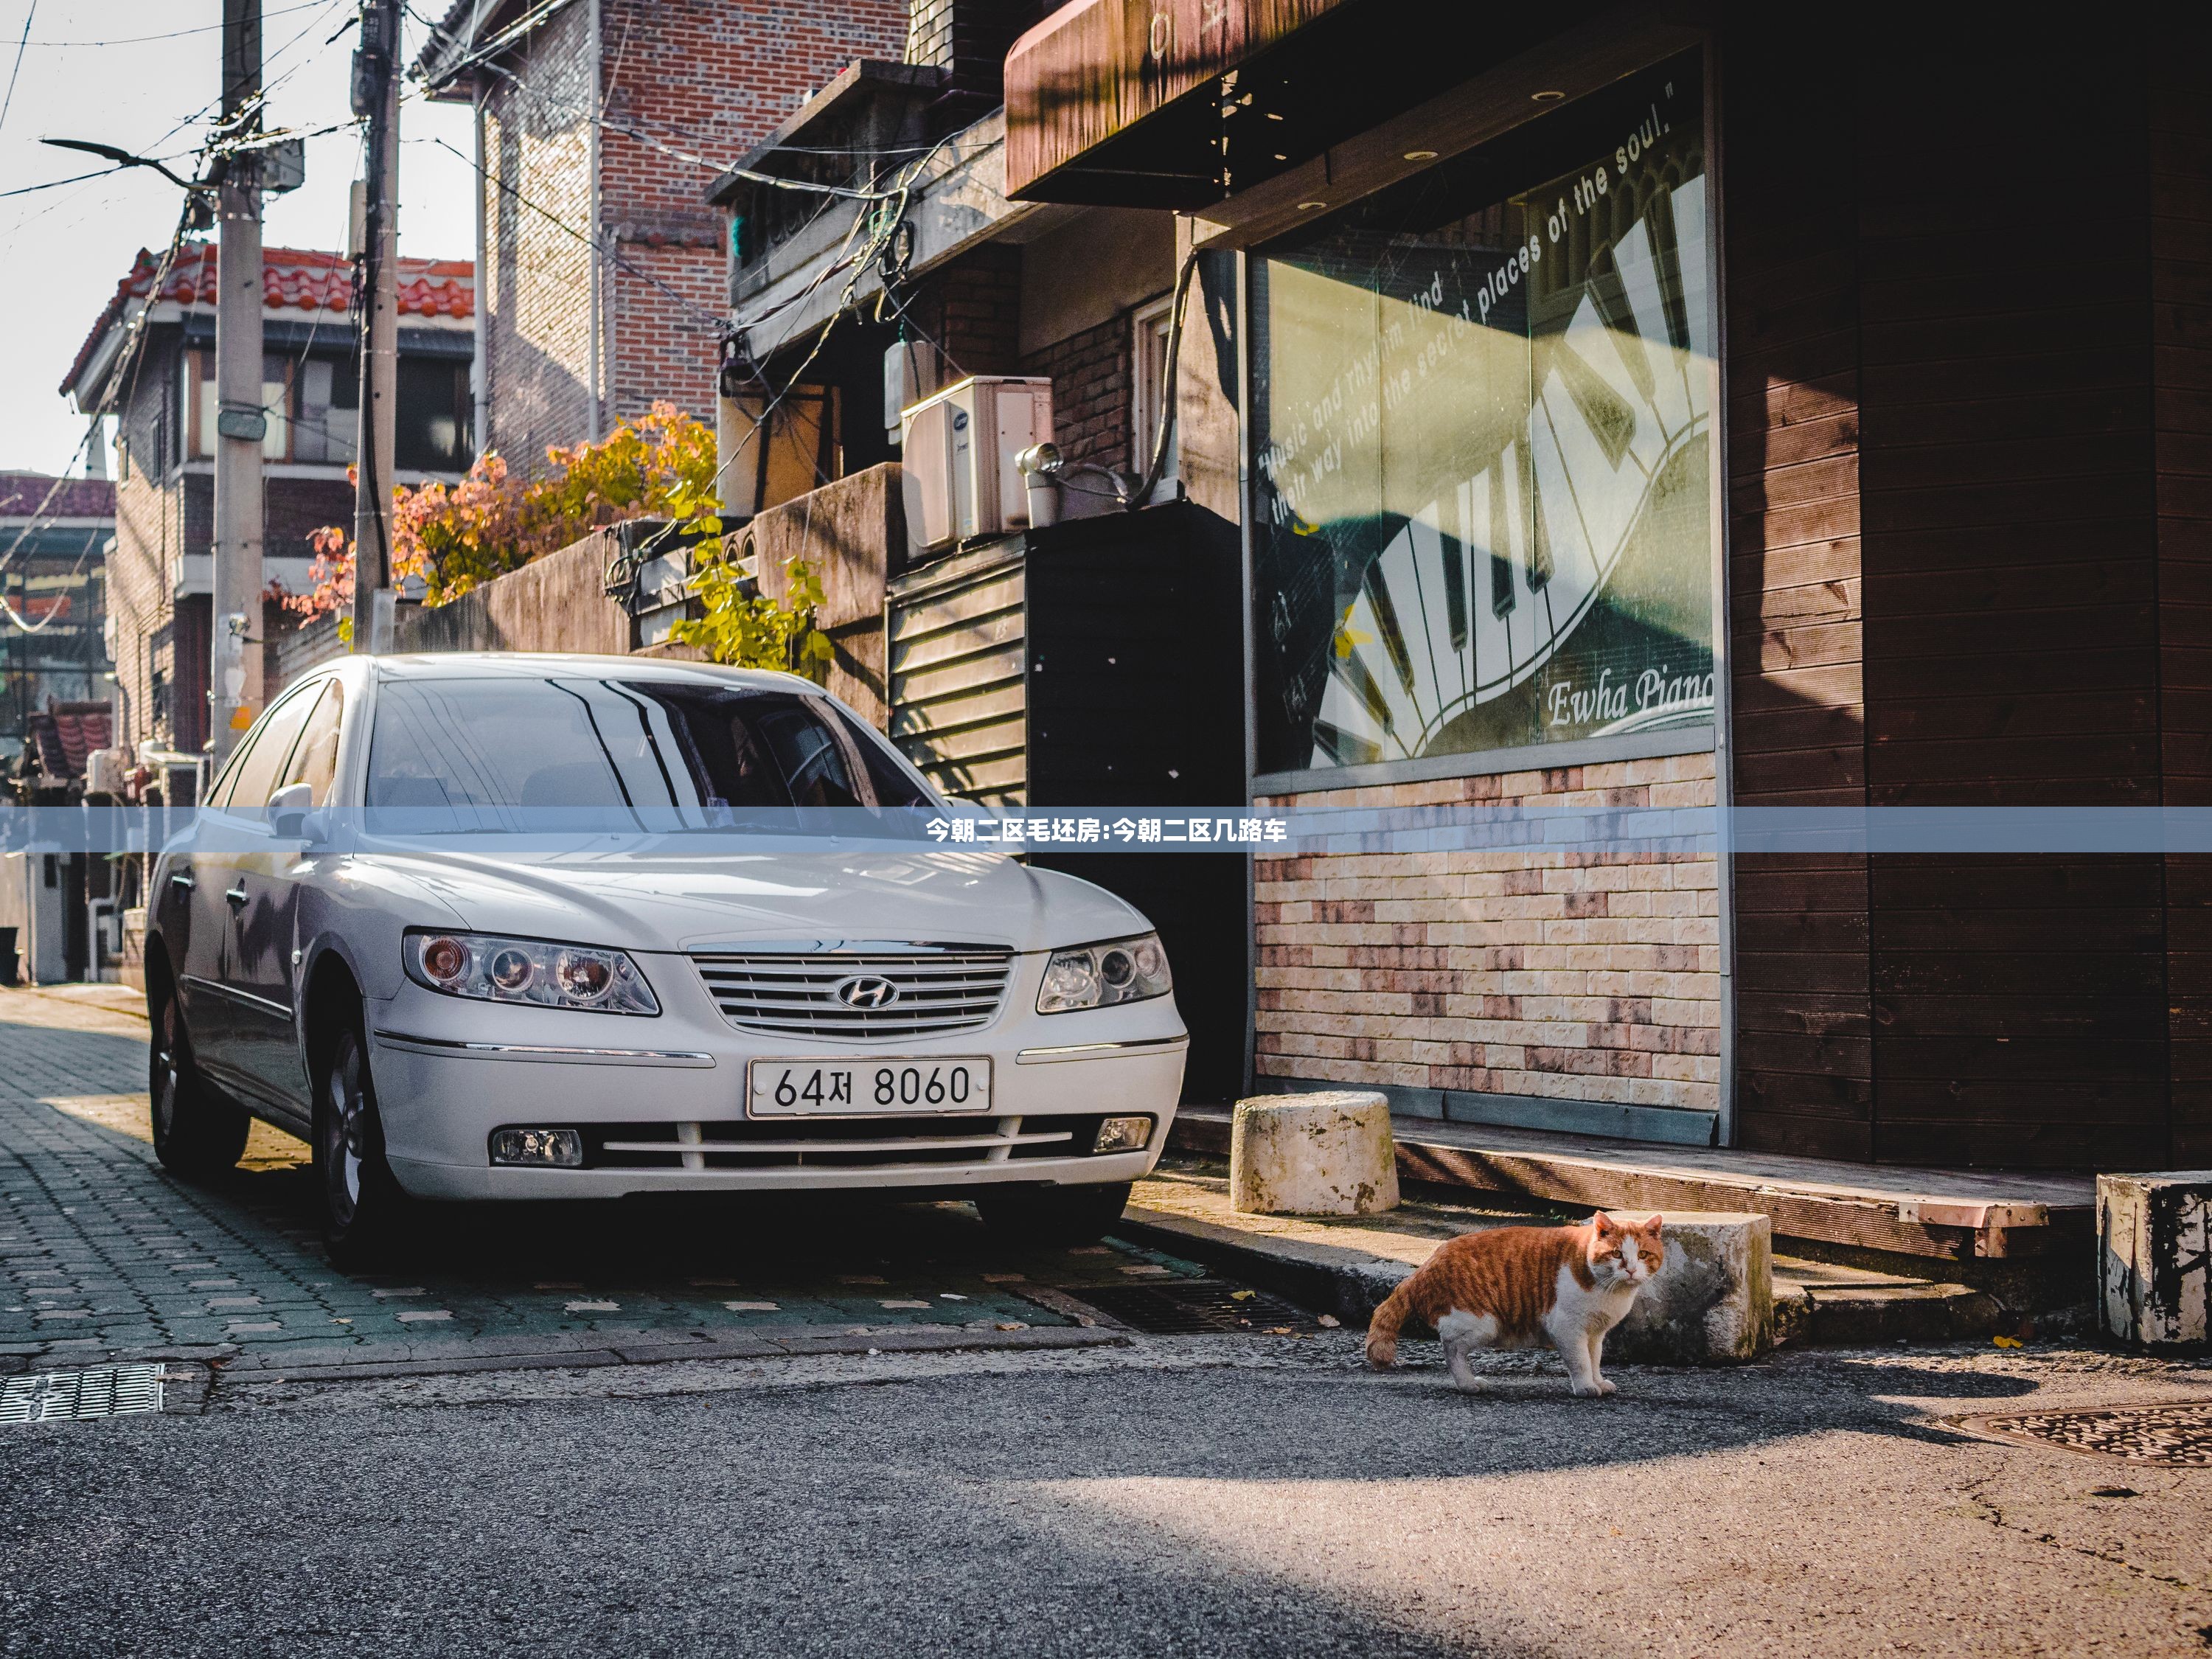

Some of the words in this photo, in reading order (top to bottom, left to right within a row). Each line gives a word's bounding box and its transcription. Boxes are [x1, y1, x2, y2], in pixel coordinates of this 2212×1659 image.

[1272, 471, 1306, 526] their
[1310, 437, 1342, 484] way
[1346, 402, 1378, 448] into
[1383, 369, 1411, 410] the
[1417, 299, 1472, 378] secret
[1478, 234, 1541, 325] places
[1549, 198, 1568, 243] of
[1573, 167, 1607, 215] the
[1312, 377, 1342, 431] and
[1408, 271, 1444, 331] find
[1548, 667, 1628, 726] Ewha
[1635, 664, 1714, 715] Piano
[775, 1069, 851, 1107] 64저
[874, 1067, 969, 1105] 8060
